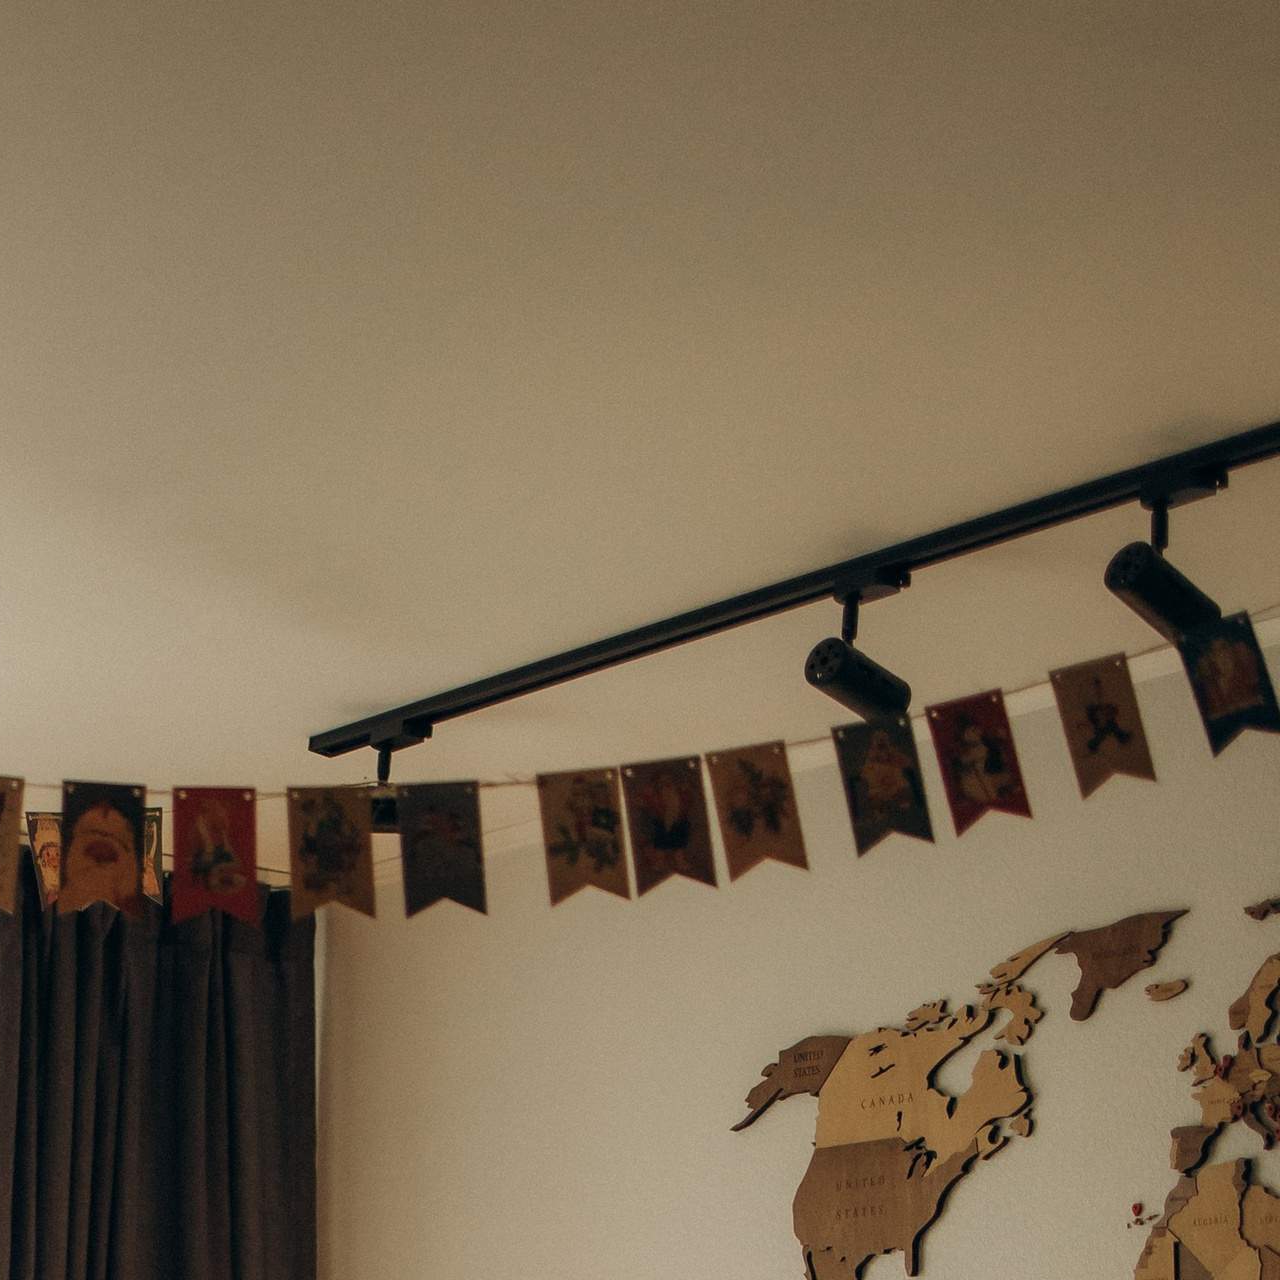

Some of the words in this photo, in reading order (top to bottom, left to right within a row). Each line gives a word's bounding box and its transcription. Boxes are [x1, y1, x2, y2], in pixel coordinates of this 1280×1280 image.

[793, 1050, 824, 1064] UNITED
[793, 1066, 821, 1078] STATES
[860, 1092, 914, 1110] CANADA
[836, 1176, 885, 1191] UNITED
[836, 1205, 883, 1219] STATES
[1192, 1215, 1228, 1226] ALGERIA
